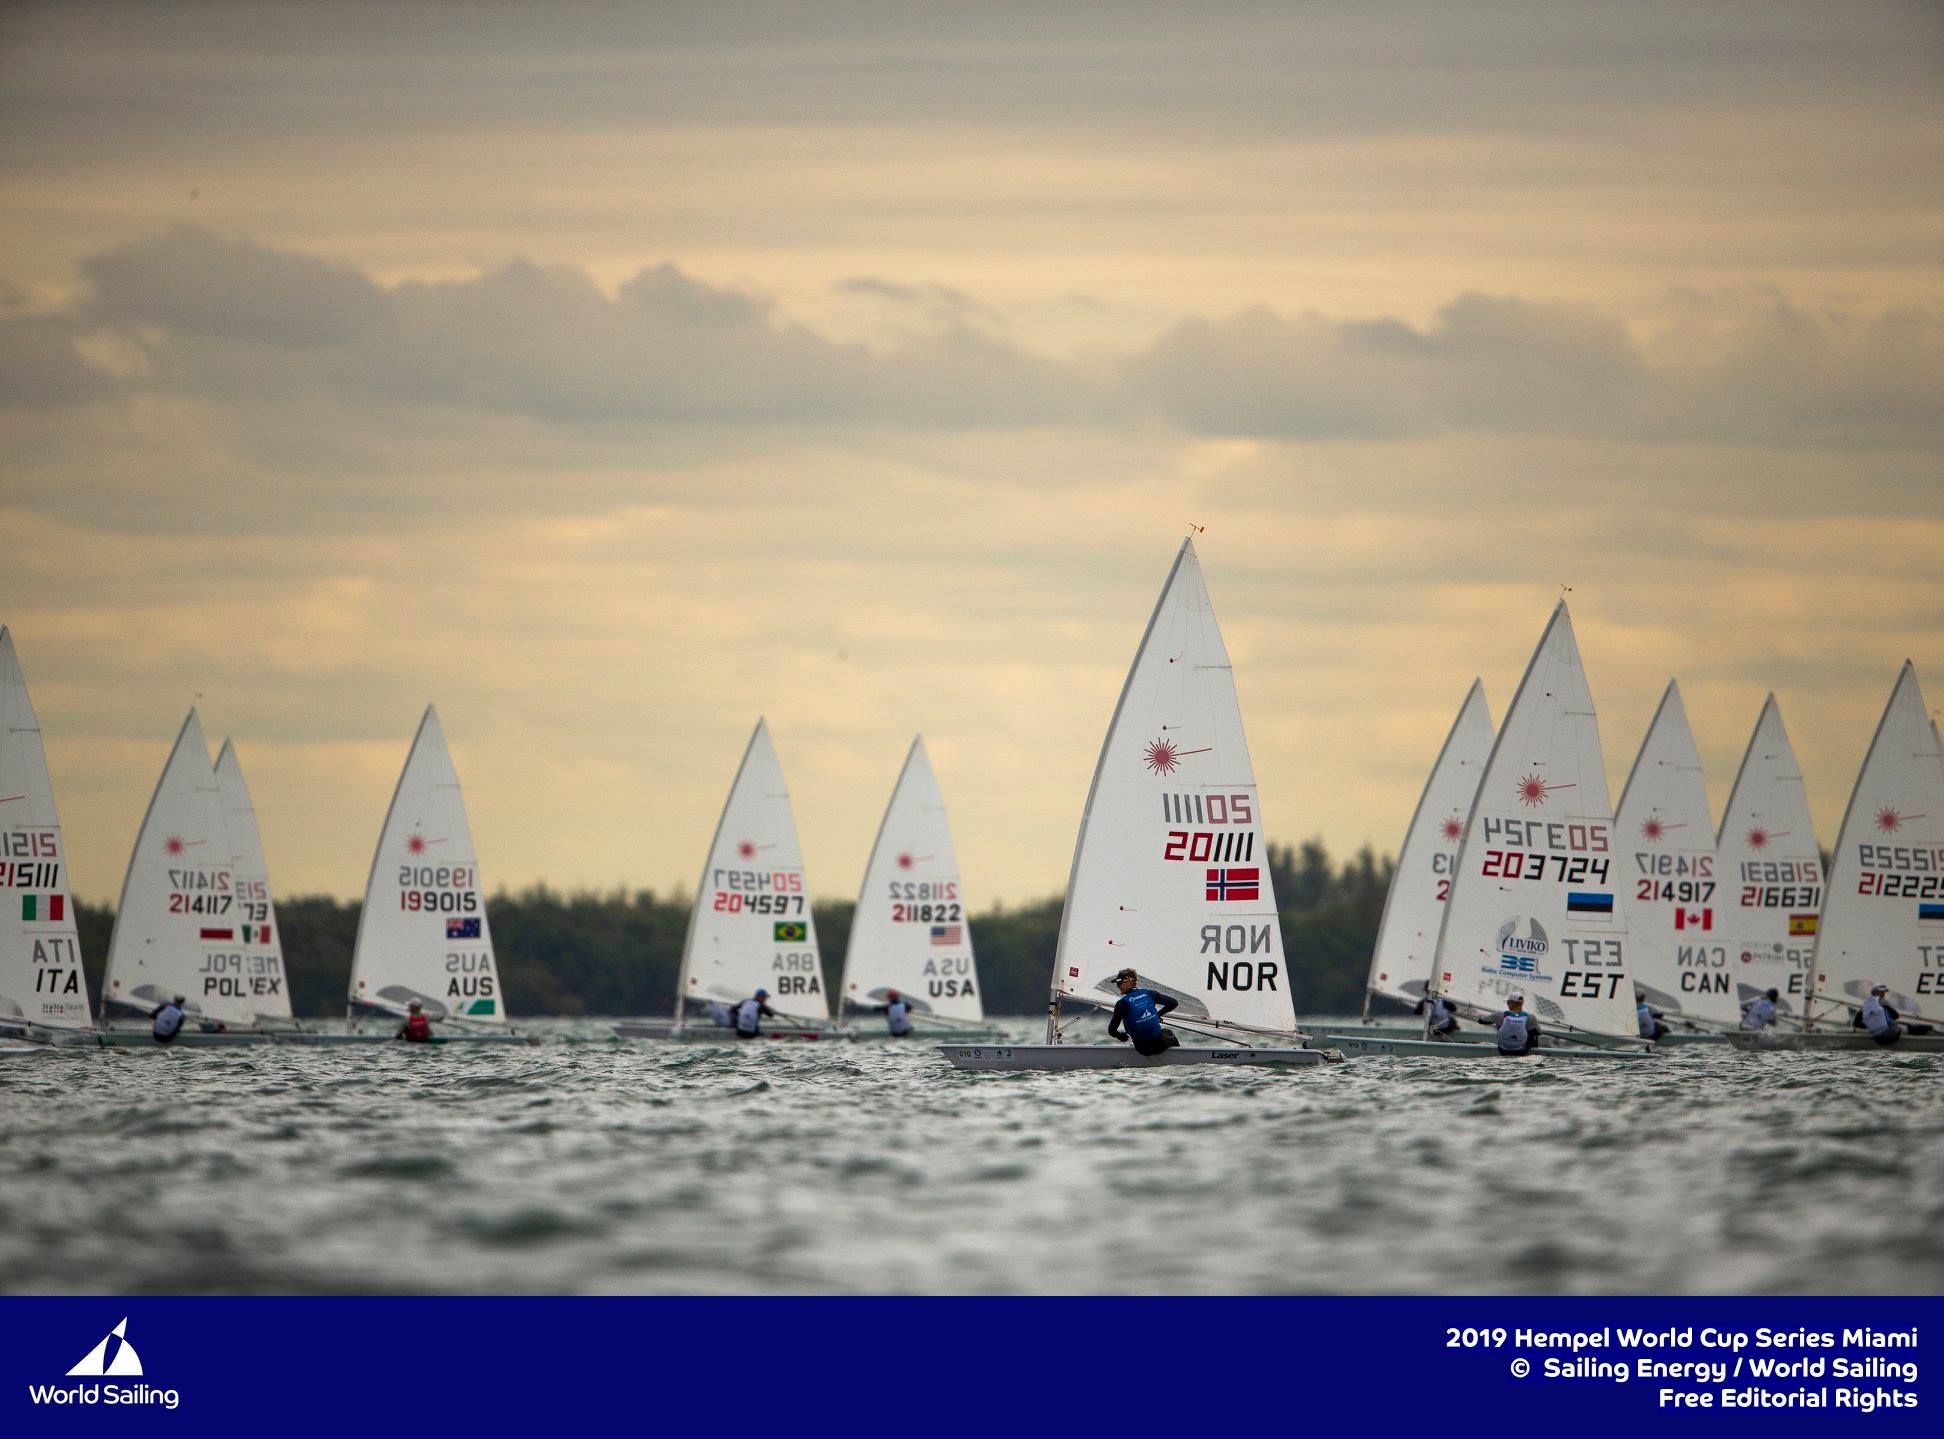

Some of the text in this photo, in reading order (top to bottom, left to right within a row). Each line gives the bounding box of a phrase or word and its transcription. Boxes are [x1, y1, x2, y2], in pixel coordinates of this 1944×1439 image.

[1164, 831, 1254, 862] 201111
[1482, 850, 1610, 884] 203724
[401, 890, 476, 912] 199015
[1636, 879, 1716, 903] 214917
[1740, 886, 1820, 908] 216631
[169, 893, 233, 914] 214117
[714, 892, 804, 914] 204597
[892, 903, 961, 922] 211822
[1509, 937, 1546, 952] LIVIKO
[36, 968, 78, 994] ITA
[447, 976, 493, 997] AUS
[778, 976, 821, 995] BRA
[1207, 962, 1278, 991] NOR
[1499, 969, 1527, 980] Computer
[1529, 972, 1553, 982] Systems
[1560, 971, 1624, 999] EST
[1681, 972, 1729, 995] CAN
[204, 977, 246, 997] POL
[929, 980, 975, 998] USA
[1211, 1051, 1240, 1059] Laser
